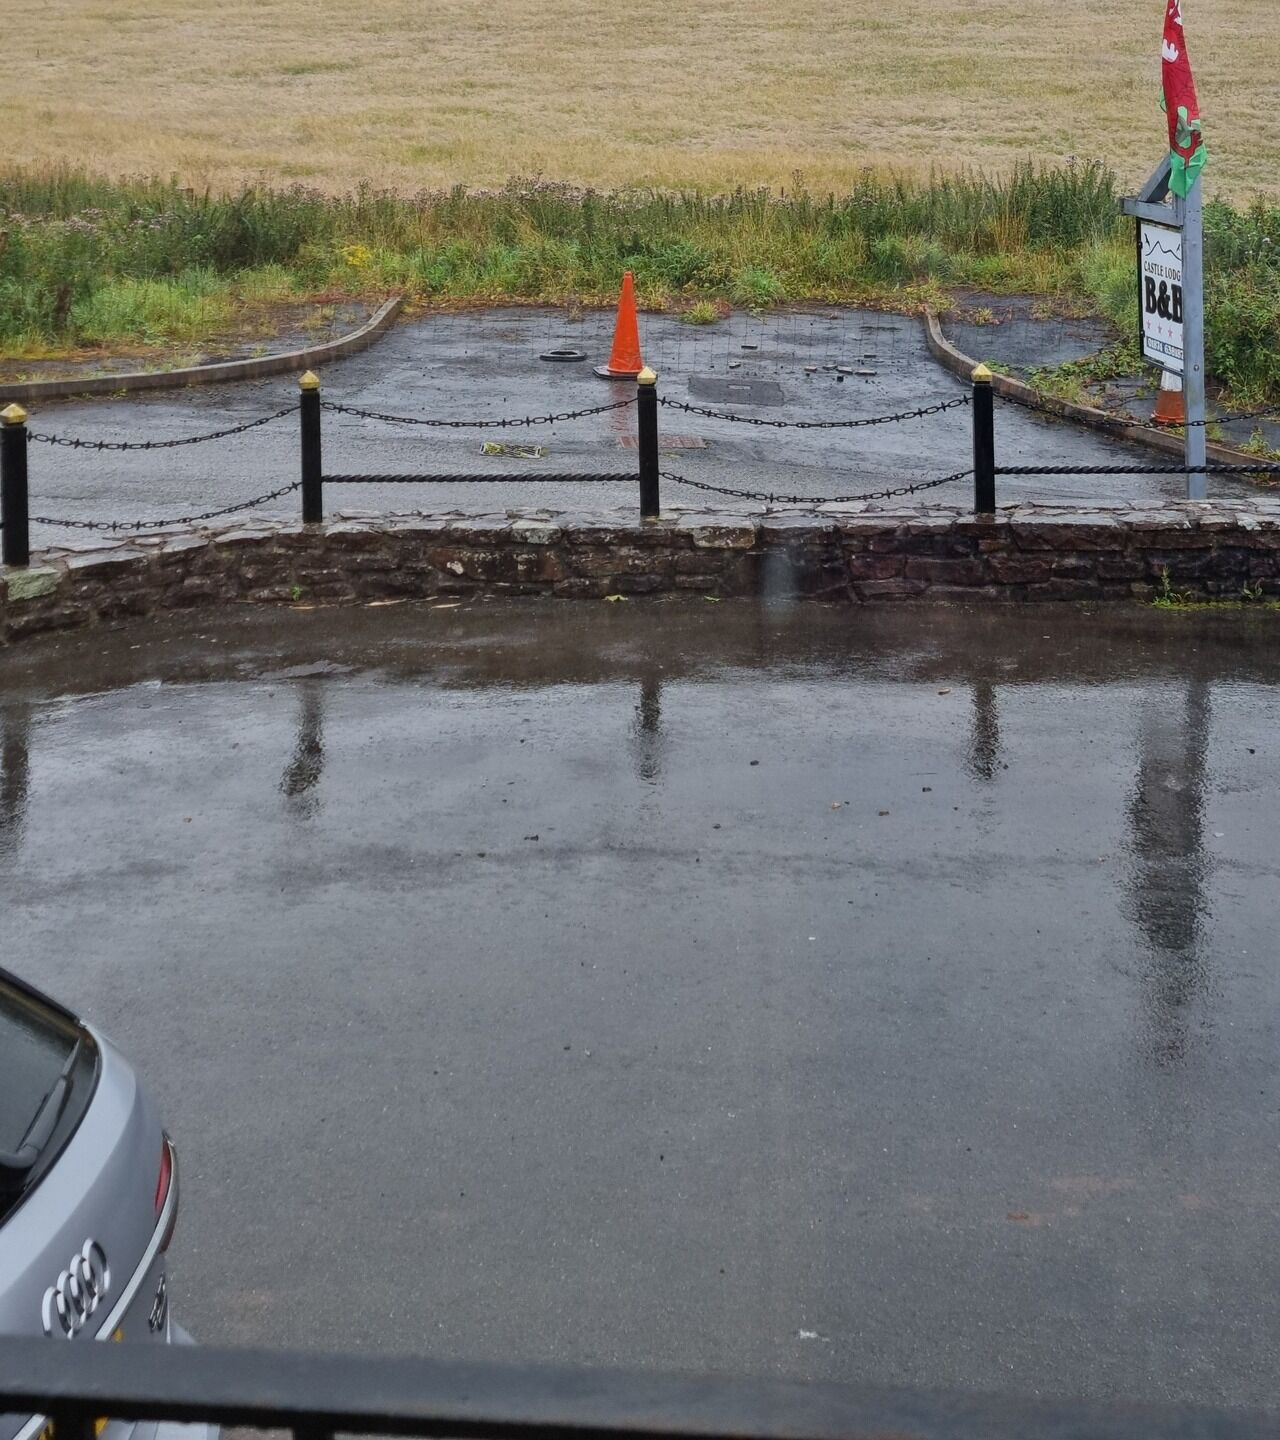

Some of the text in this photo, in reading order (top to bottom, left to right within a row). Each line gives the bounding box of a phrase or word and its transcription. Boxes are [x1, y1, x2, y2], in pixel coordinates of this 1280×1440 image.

[1144, 260, 1181, 281] CASTLE LODG
[1144, 275, 1183, 324] B&B
